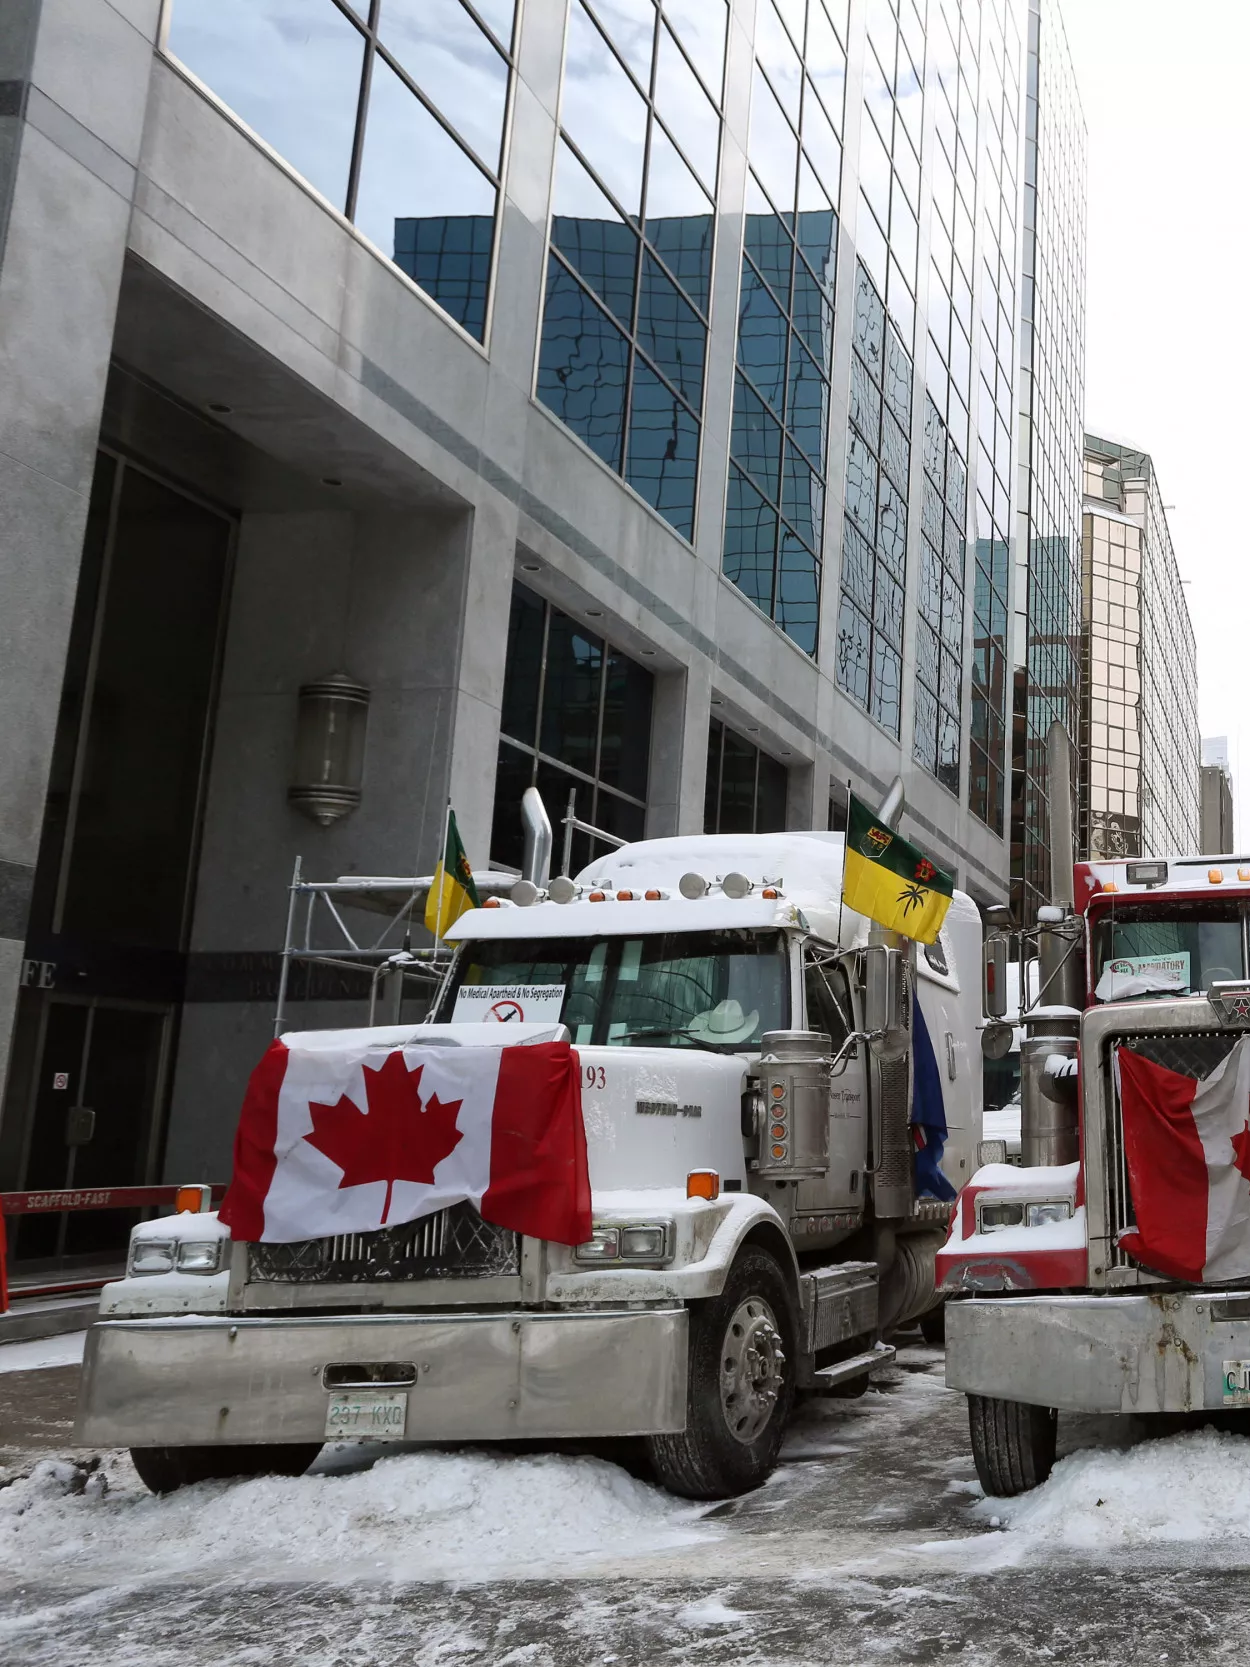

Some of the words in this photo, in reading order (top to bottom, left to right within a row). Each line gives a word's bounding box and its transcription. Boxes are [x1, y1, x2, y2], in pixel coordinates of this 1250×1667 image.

[459, 987, 467, 998] No
[468, 987, 488, 998] Medical
[489, 987, 517, 1000] Apartheid
[522, 987, 530, 998] No
[531, 986, 563, 1001] Segregation
[27, 1192, 111, 1209] SCAFFOLD-FAST
